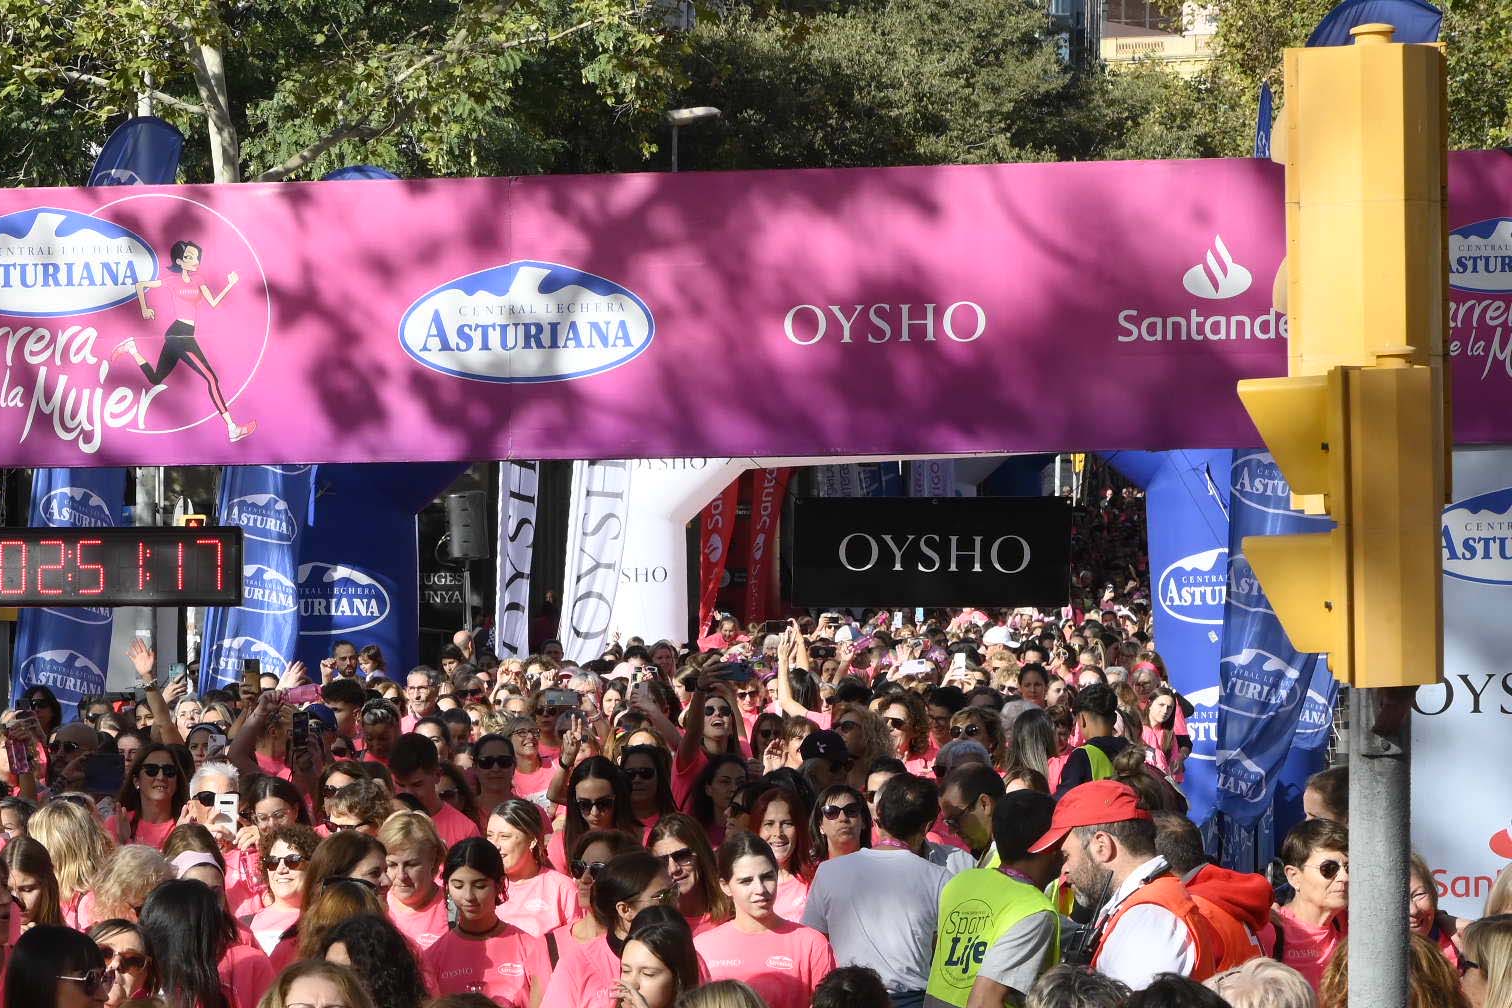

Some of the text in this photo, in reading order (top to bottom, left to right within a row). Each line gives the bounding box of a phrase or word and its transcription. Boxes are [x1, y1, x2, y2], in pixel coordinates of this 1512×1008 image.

[458, 302, 626, 316] CENTRAL LECHERA
[783, 301, 986, 346] OYSHO
[1118, 308, 1288, 341] Santande
[419, 308, 634, 353] ASTURIANA
[0, 366, 25, 408] la
[20, 360, 168, 453] Mujer
[570, 460, 627, 640] OYSH
[837, 532, 1031, 574] OYSHO
[1181, 574, 1227, 584] CENTRA
[946, 911, 990, 938] Sport
[944, 934, 988, 974] Life
